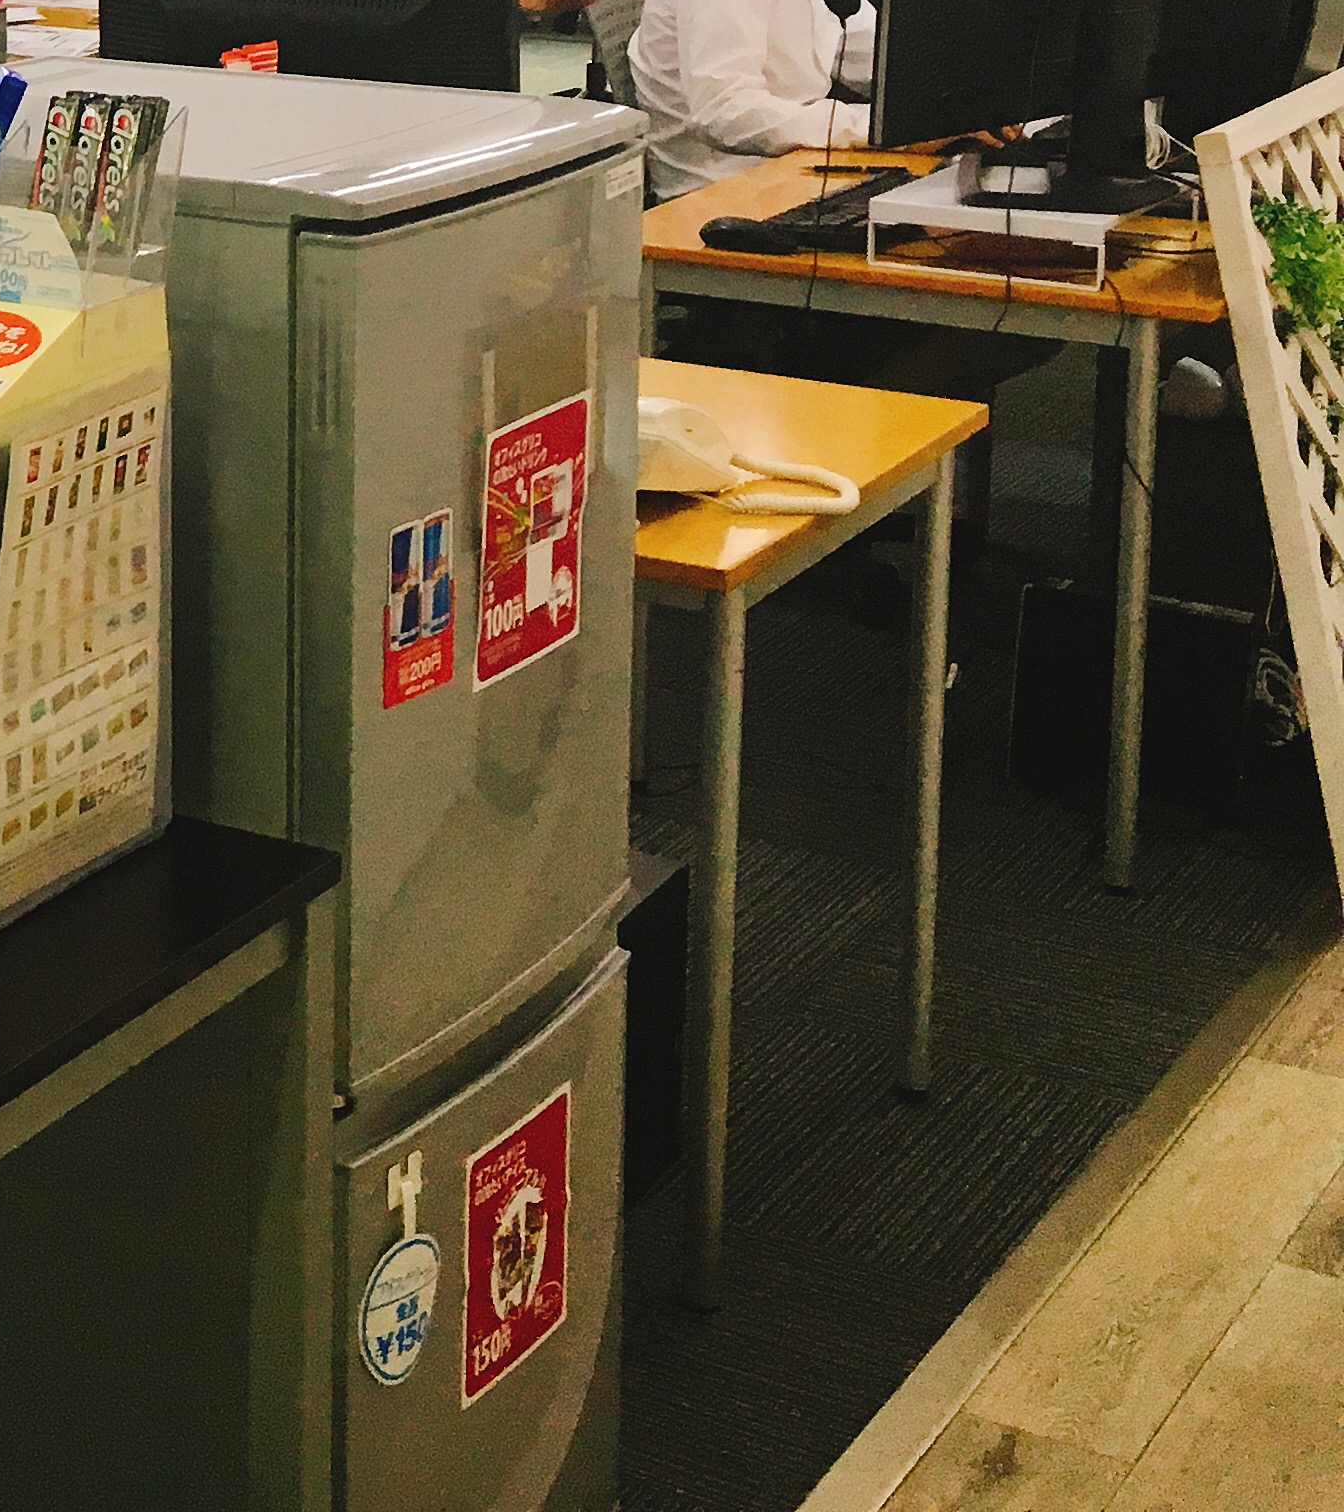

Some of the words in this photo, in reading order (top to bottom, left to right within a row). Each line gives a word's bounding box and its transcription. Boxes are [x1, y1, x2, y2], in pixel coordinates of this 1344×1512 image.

[103, 108, 135, 213] Clorets
[483, 598, 524, 641] 100円
[410, 650, 442, 682] 200円
[473, 1328, 512, 1377] 150円
